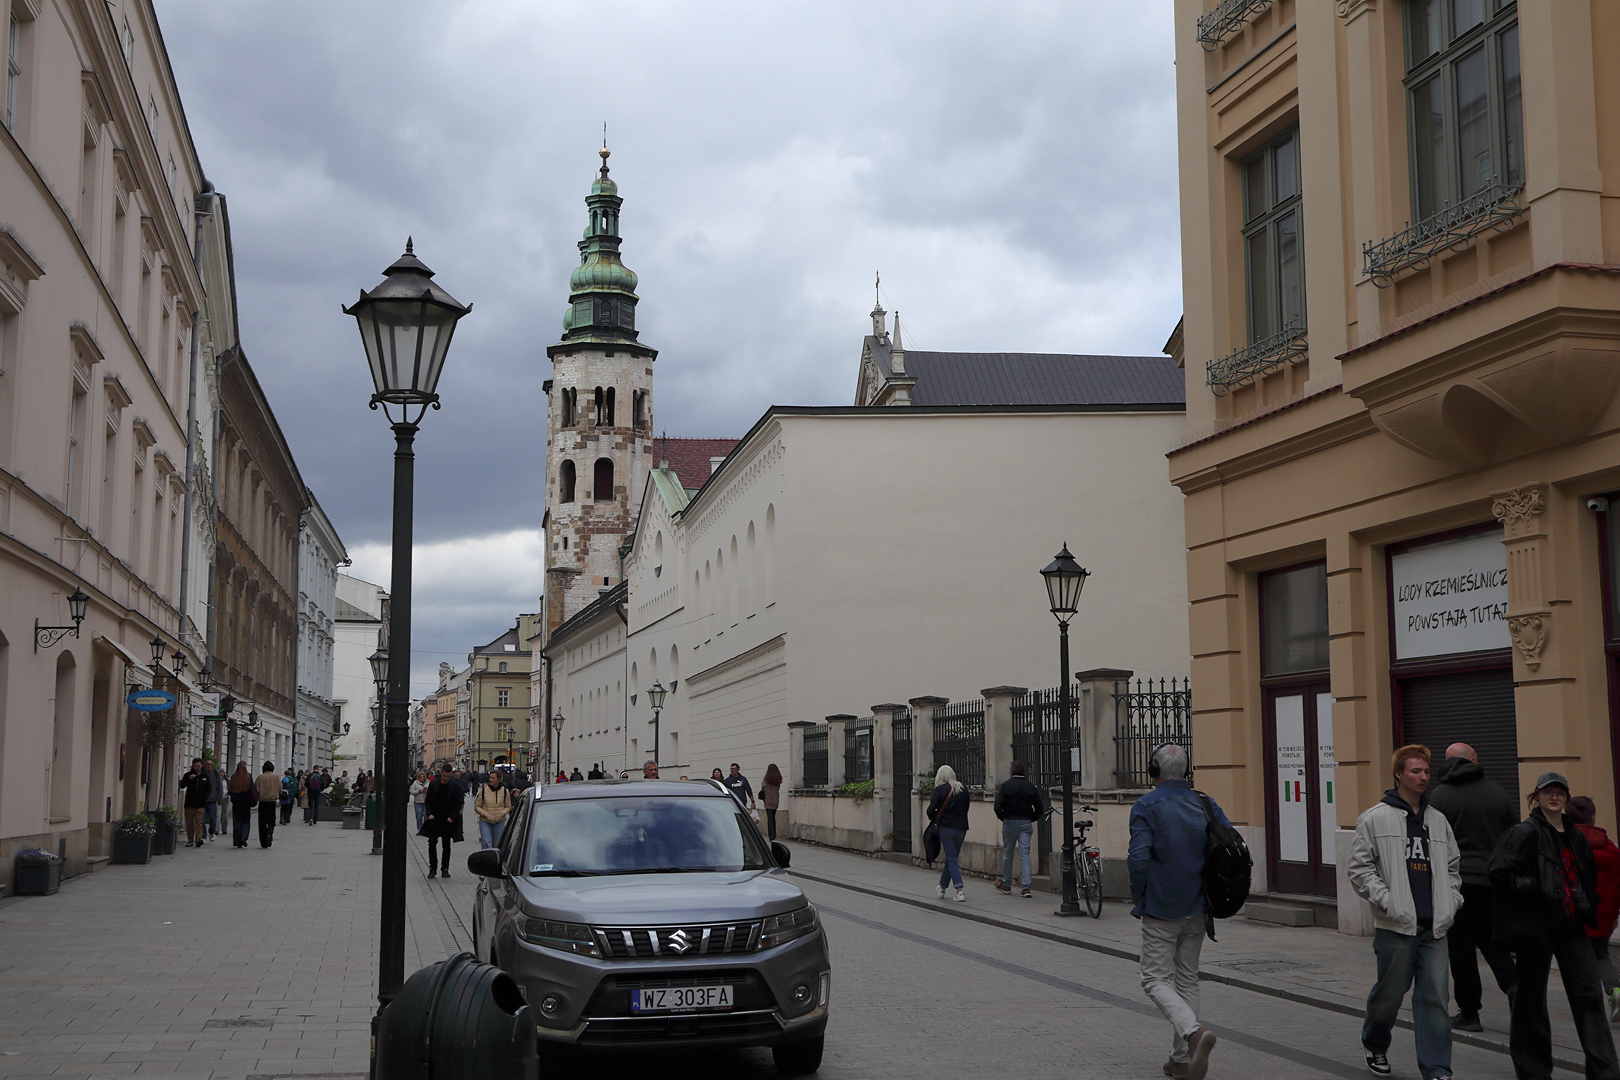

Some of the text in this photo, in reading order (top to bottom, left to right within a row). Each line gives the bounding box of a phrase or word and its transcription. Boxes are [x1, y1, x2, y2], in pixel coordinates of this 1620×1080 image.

[1399, 584, 1422, 602] LODY
[1408, 602, 1508, 632] POWSTAJĄ TUTAJ
[1410, 862, 1428, 872] PARIS
[644, 987, 728, 1008] WZ 303FA
